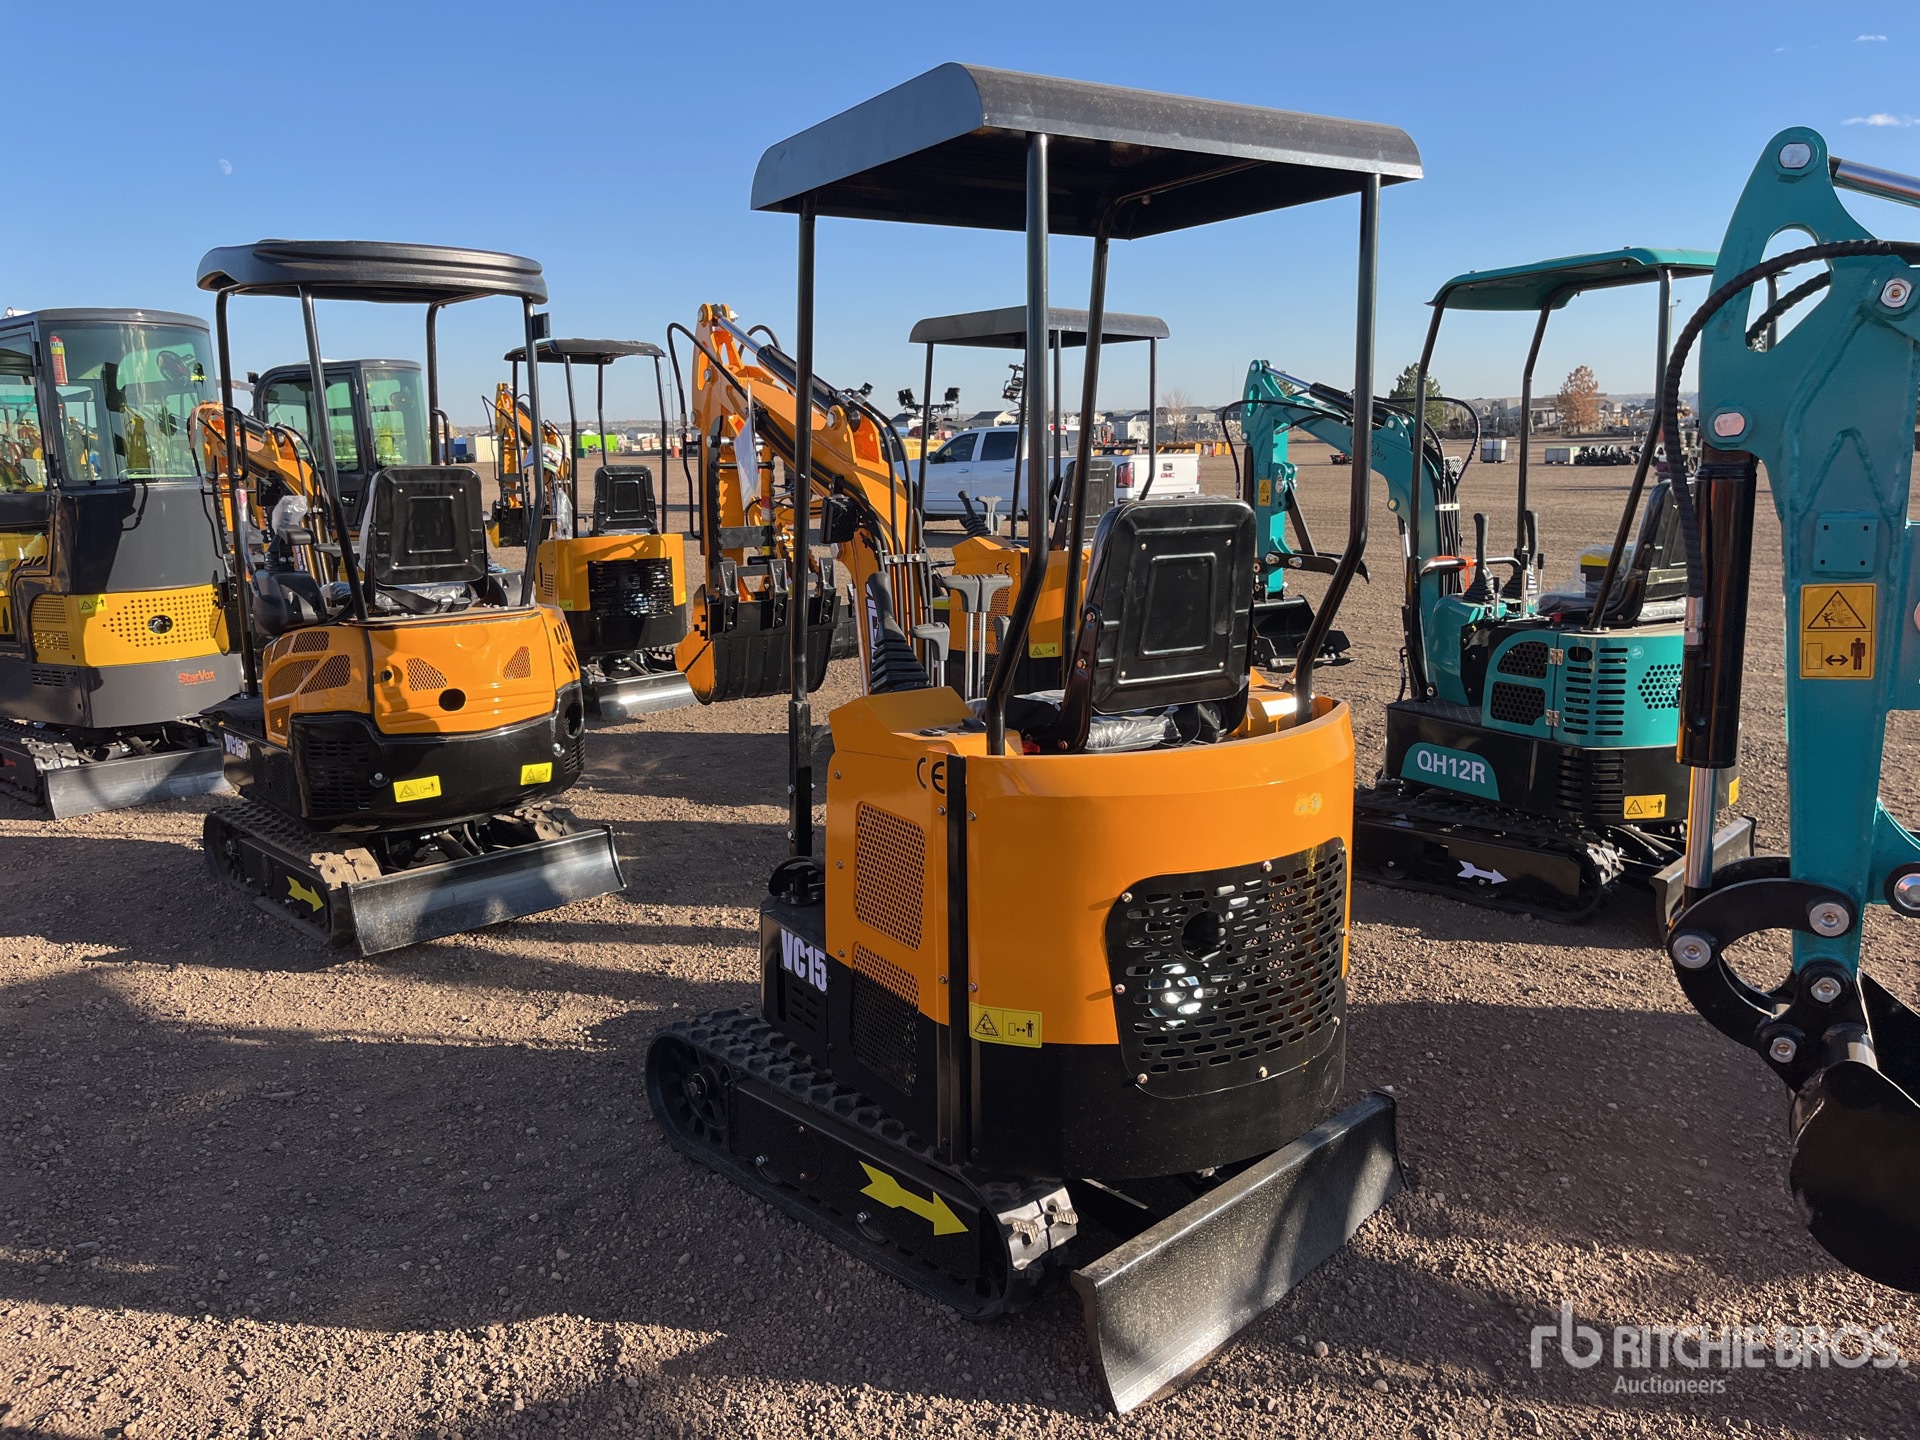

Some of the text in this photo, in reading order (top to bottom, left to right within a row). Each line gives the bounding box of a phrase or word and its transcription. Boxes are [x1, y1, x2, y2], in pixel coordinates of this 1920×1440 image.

[178, 669, 215, 683] StarVox
[916, 757, 945, 794] CE
[1417, 749, 1486, 784] QH12R
[781, 928, 827, 992] VC15
